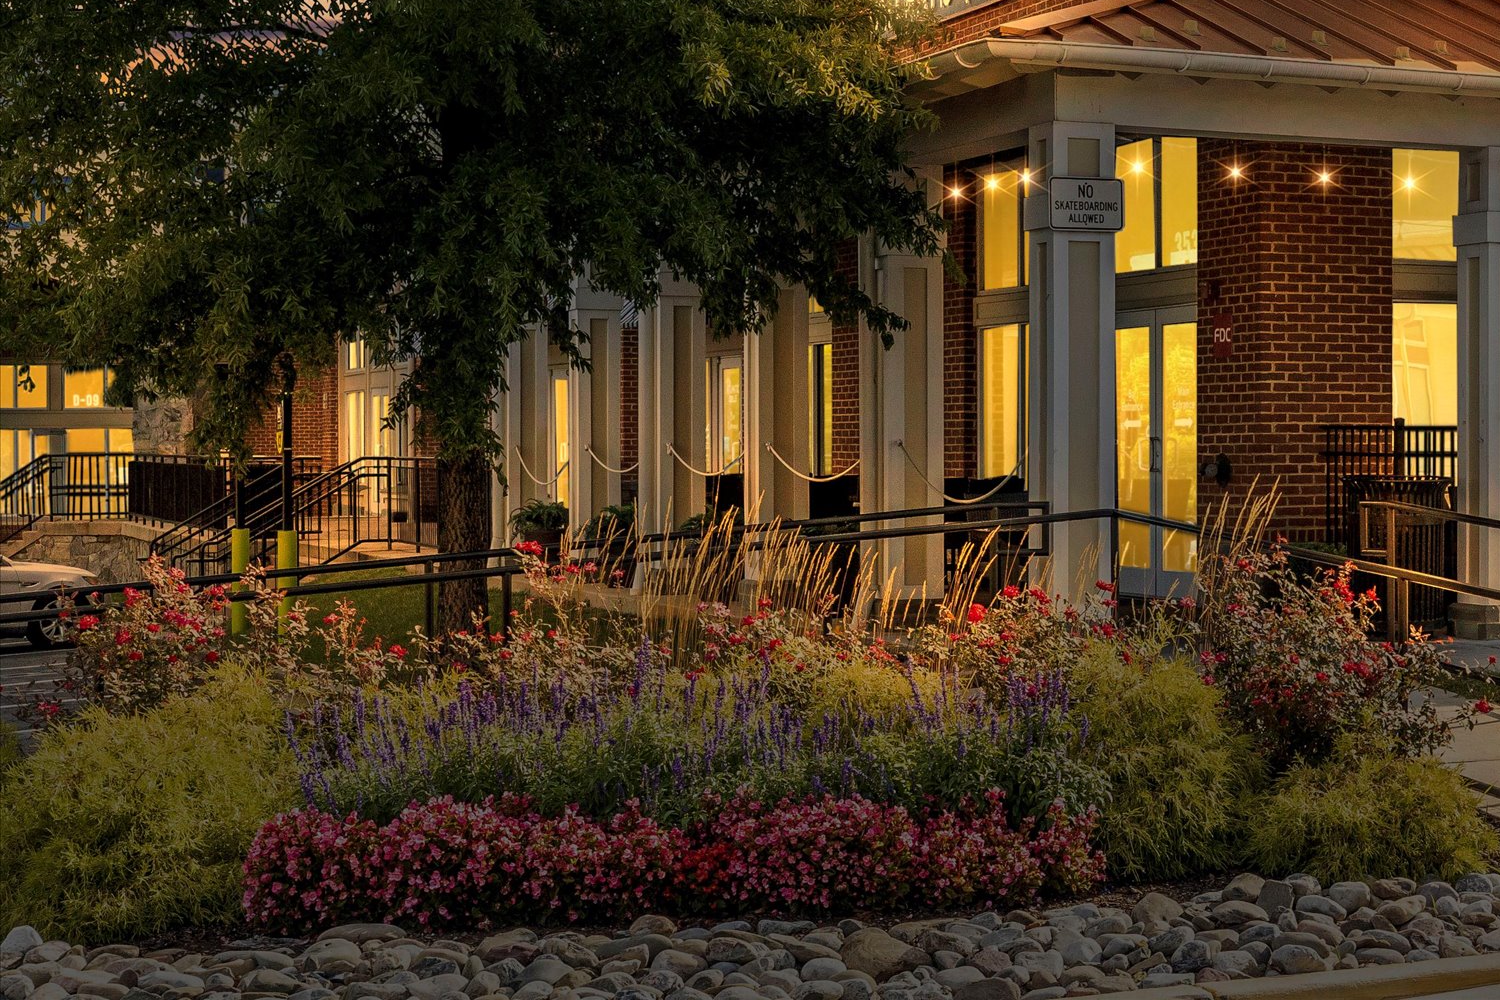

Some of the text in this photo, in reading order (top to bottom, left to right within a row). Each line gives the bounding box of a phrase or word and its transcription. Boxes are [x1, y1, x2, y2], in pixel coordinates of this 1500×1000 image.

[1078, 184, 1094, 198] NO
[1054, 200, 1119, 212] SKATEBOARDING
[1068, 214, 1105, 225] ALLOWED
[1214, 327, 1232, 343] FDC
[73, 393, 100, 407] D-09
